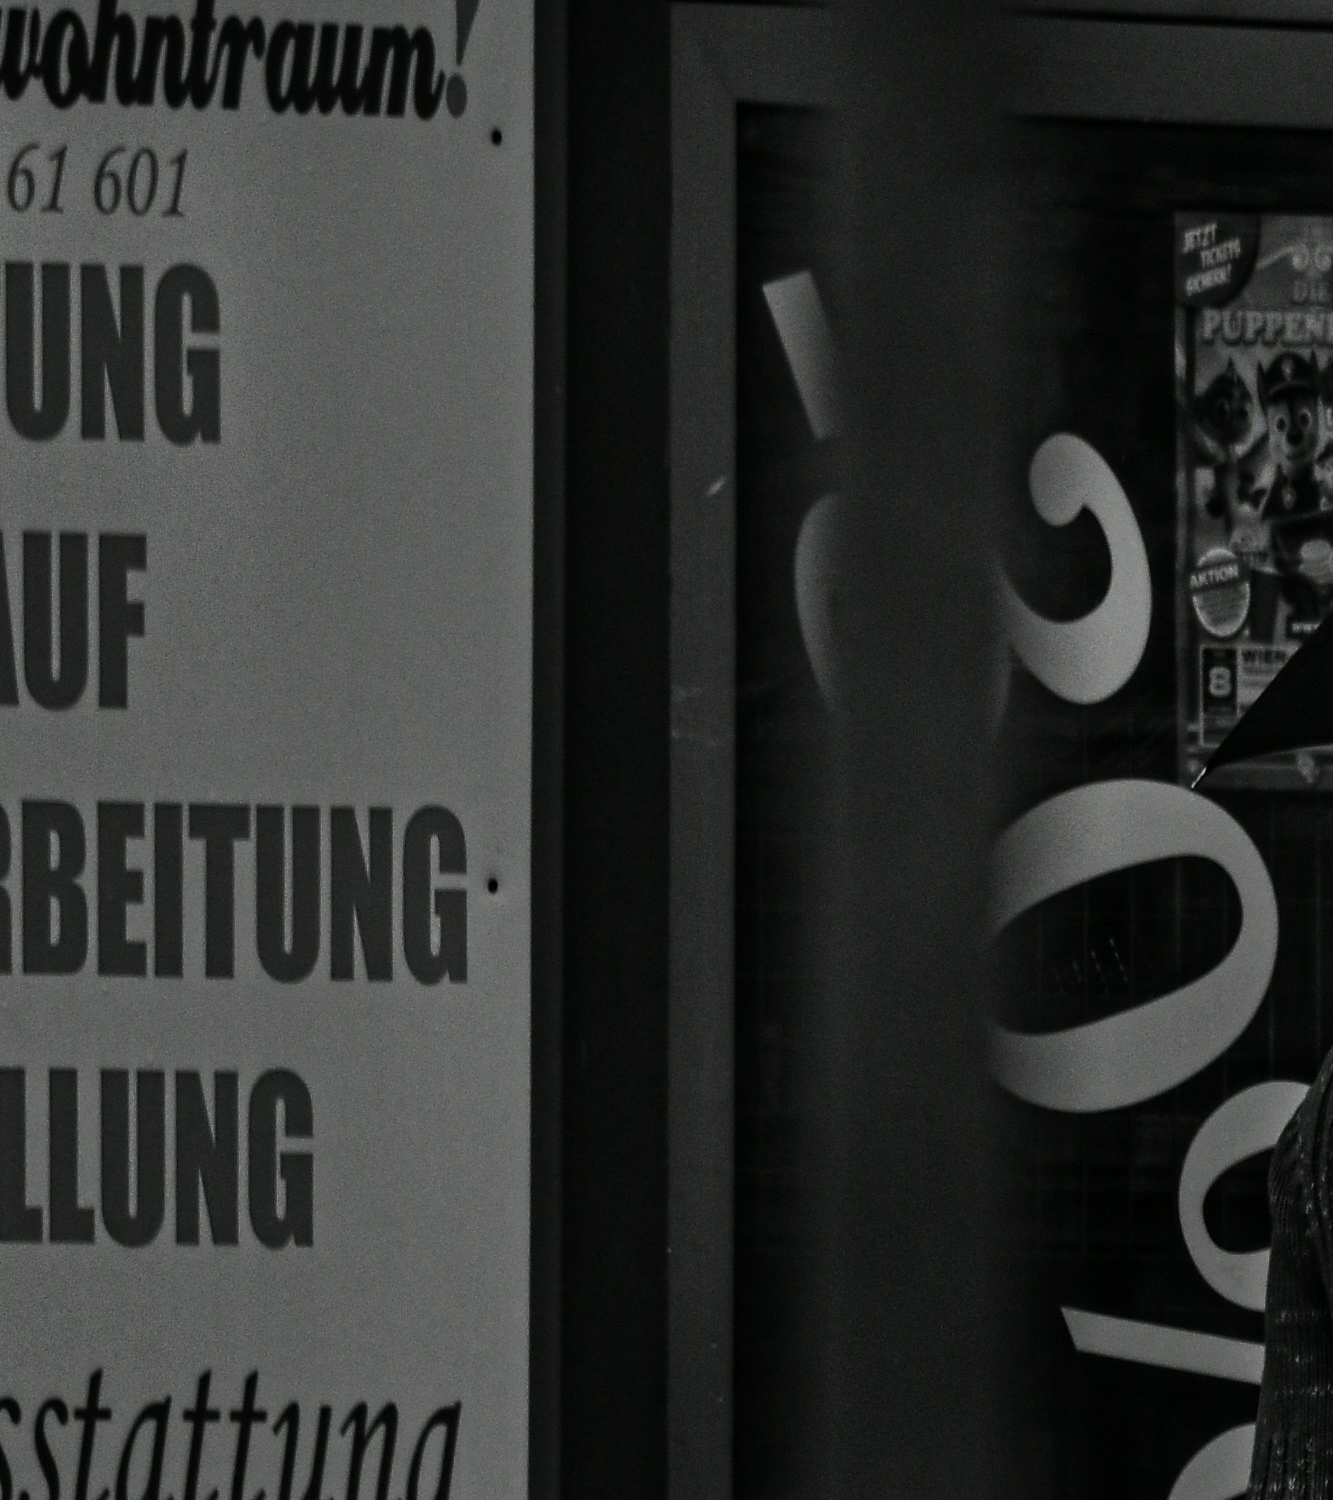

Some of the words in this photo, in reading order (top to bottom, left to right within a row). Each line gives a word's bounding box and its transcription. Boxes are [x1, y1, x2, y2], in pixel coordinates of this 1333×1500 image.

[7, 143, 68, 214] 61
[93, 145, 188, 217] 601
[4, 259, 222, 448] UNG
[1189, 562, 1240, 591] AKTION
[1208, 665, 1232, 698] 8
[0, 798, 469, 988] BEITUNG
[0, 1067, 315, 1252] LLUNG
